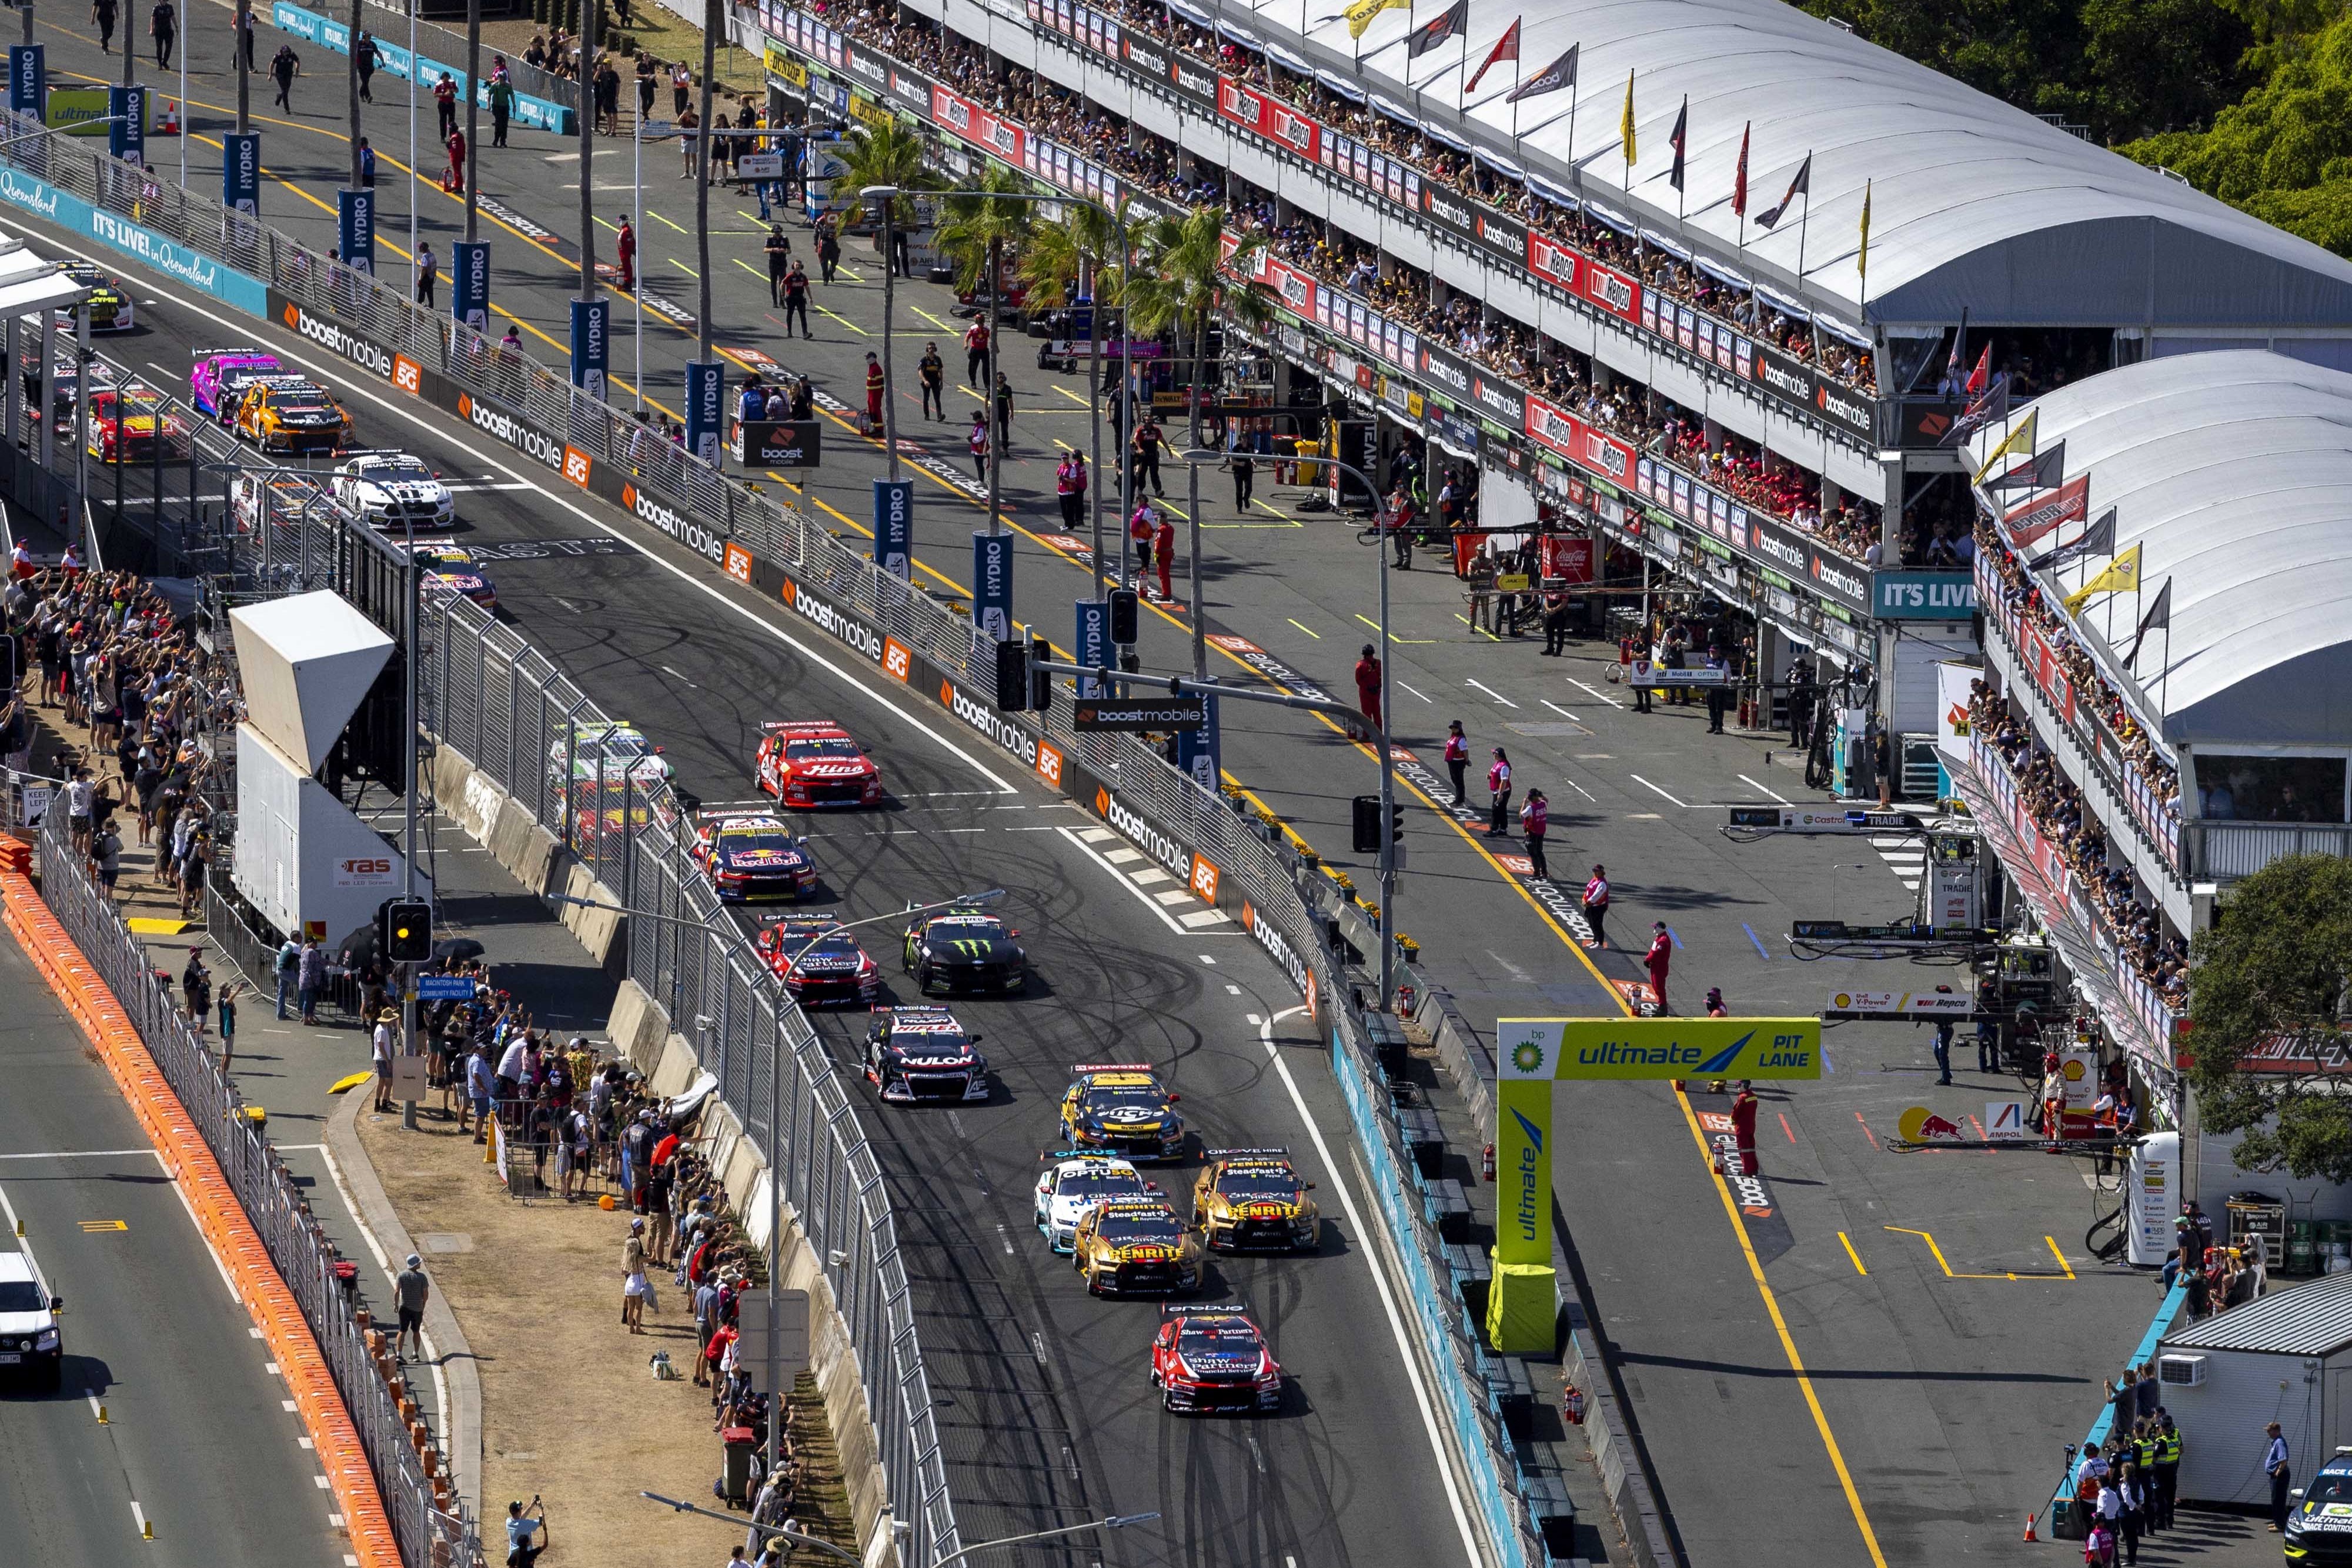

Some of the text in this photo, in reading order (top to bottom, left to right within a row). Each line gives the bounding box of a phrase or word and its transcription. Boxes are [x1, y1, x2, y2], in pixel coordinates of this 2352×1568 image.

[22, 51, 34, 99] HYDRO
[773, 55, 800, 81] DUNLOP
[127, 92, 139, 141] HYDRO
[1238, 91, 1259, 123] Repco
[1289, 117, 1309, 149] Repco
[240, 140, 253, 189] HYDRO
[1, 171, 57, 218] Queensland
[355, 197, 368, 248] HYDRO
[1432, 196, 1470, 230] boostmobile
[93, 211, 215, 290] IT'S LIVE! in Queensland
[1484, 221, 1523, 256] boostmobile
[471, 249, 484, 299] HYDRO
[1551, 246, 1573, 283] Repco
[1284, 272, 1307, 306] Repco
[1607, 273, 1630, 310] Repco
[1643, 289, 1656, 313] LIQUI
[1643, 308, 1656, 332] MOLY
[1661, 298, 1674, 323] LIQUI
[1679, 307, 1694, 333] LIQUI
[299, 308, 390, 376] boostmobile
[589, 307, 601, 359] HYDRO
[1661, 318, 1674, 342] MOLY
[1679, 328, 1693, 351] MOLY
[1699, 318, 1712, 341] LIQUI
[1718, 327, 1732, 352] LIQUI
[1699, 336, 1712, 360] MOLY
[1718, 347, 1731, 370] MOLY
[1736, 337, 1752, 362] LIQUI
[397, 367, 417, 391] 5G
[1736, 357, 1751, 380] MOLY
[1766, 361, 1808, 400] boostmobile
[704, 370, 717, 423] HYDRO
[1826, 390, 1869, 430] boostmobile
[472, 397, 561, 469] boostmobile
[1547, 412, 1571, 446] Repco
[762, 448, 803, 459] boost
[1364, 426, 1377, 463] TEAM
[566, 459, 586, 483] 5G
[1509, 451, 1519, 466] HUB
[1603, 442, 1626, 476] Repco
[637, 489, 723, 562] boostmobile
[890, 488, 903, 543] HYDRO
[1760, 530, 1803, 570] boostmobile
[729, 558, 747, 580] 5G
[1820, 564, 1863, 601] boostmobile
[1885, 584, 1924, 606] IT'S
[796, 584, 880, 660] boostmobile
[887, 653, 905, 676] 5G
[954, 686, 1035, 764] boostmobile
[1098, 709, 1201, 723] boostmobile
[1956, 723, 1968, 734] H
[803, 764, 865, 776] Hino
[1040, 755, 1059, 779] 5G
[1870, 817, 1905, 825] TRADIE
[1110, 793, 1189, 879] boostmobile
[348, 859, 391, 872] ras
[732, 855, 802, 867] Red Bull
[1254, 908, 1307, 994] boostmobile
[1531, 1029, 1545, 1040] bp
[1773, 1035, 1803, 1049] PIT
[900, 1055, 973, 1065] NULON
[1579, 1041, 1702, 1065] ultimate
[1759, 1053, 1809, 1067] LANE
[1055, 1149, 1117, 1157] OPTUS
[1227, 1168, 1275, 1176] Steadfast
[1518, 1148, 1536, 1241] ultimate
[1227, 1205, 1303, 1219] PENRITE
[1108, 1248, 1185, 1261] PENRITE
